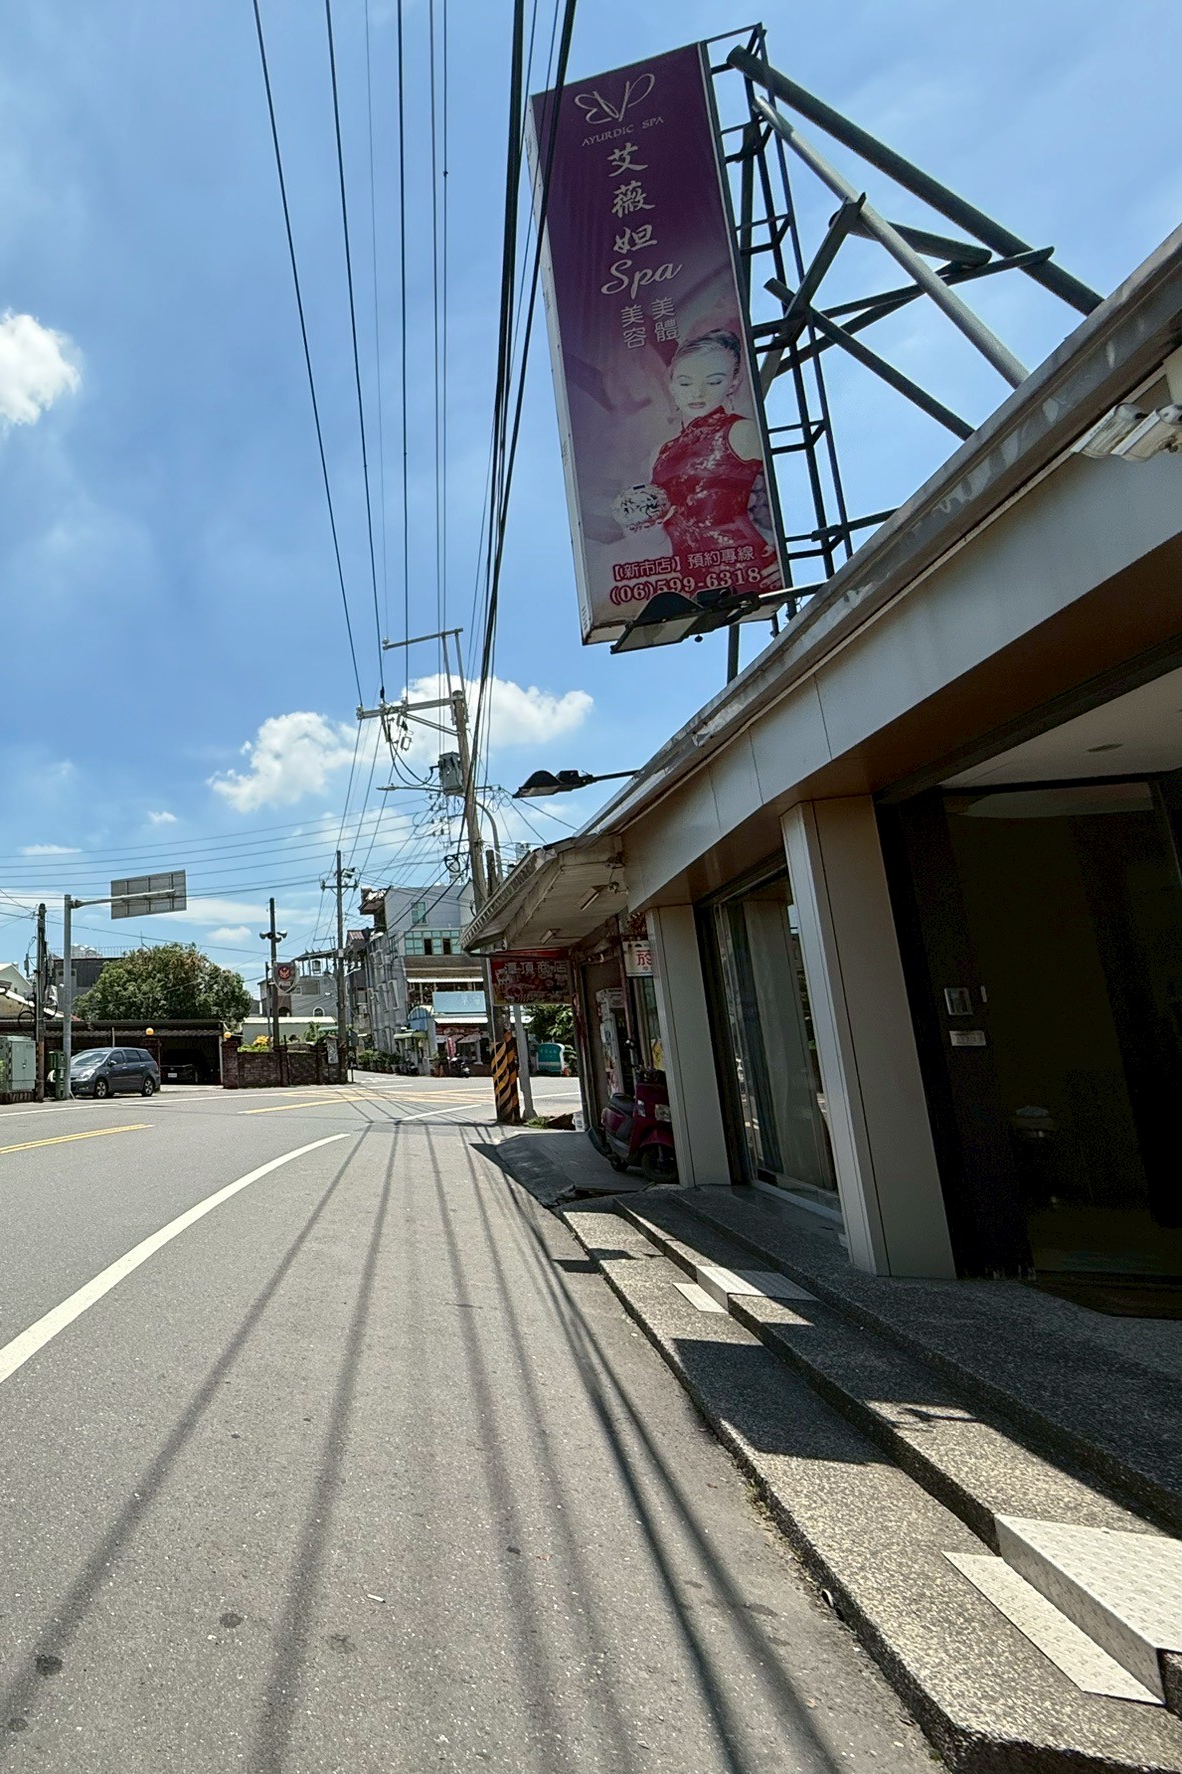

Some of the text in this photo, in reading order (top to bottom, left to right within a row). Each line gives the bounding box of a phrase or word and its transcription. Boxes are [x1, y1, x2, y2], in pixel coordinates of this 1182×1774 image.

[582, 116, 665, 147] AYURDIC SPA
[607, 142, 658, 255] 艾薇妲
[601, 259, 683, 300] Spa
[620, 303, 647, 350] 美容
[651, 296, 680, 343] 美體
[687, 545, 755, 571] 預約專線
